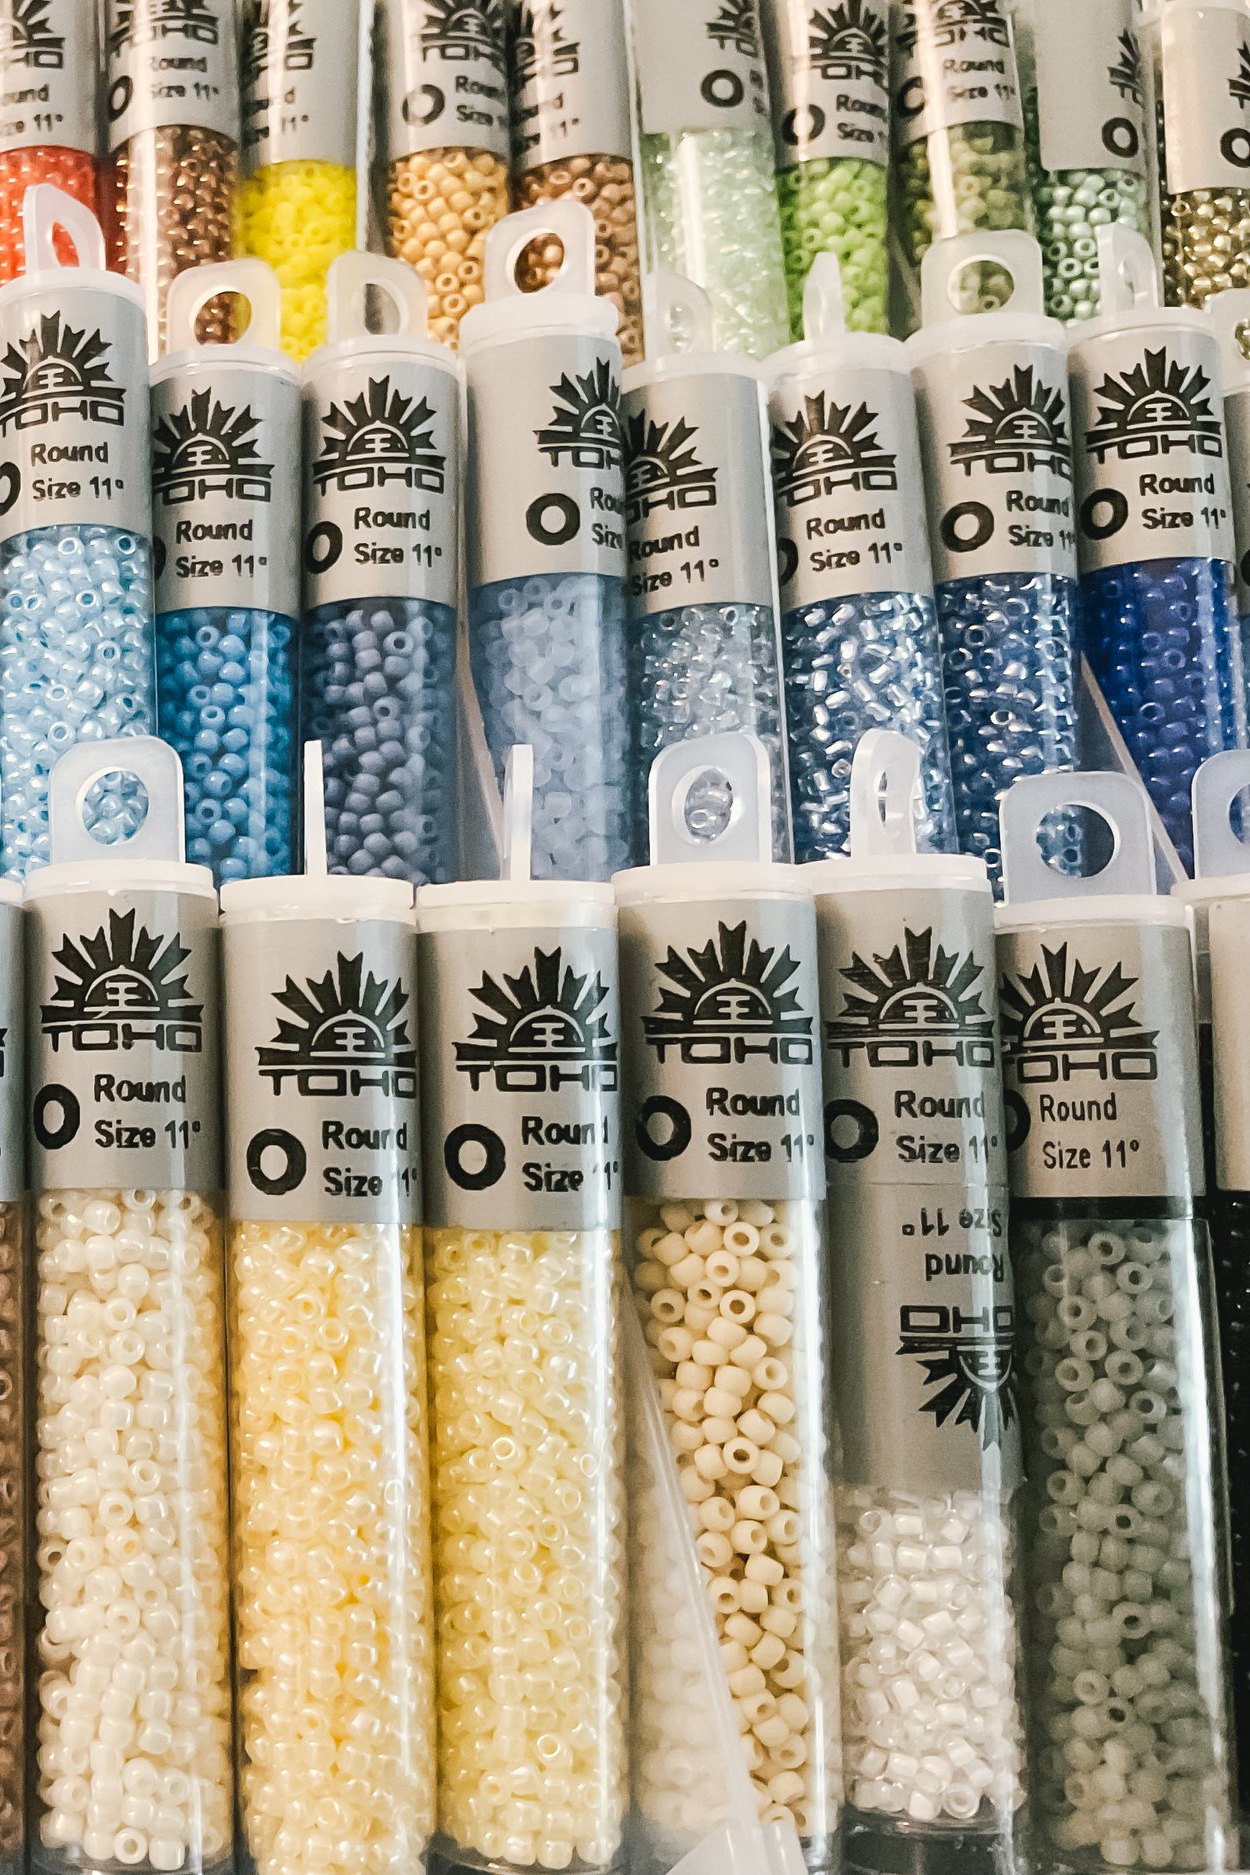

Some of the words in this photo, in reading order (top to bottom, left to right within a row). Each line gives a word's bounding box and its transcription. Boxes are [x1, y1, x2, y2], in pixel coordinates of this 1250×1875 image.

[31, 442, 108, 466] Round
[540, 444, 622, 471] TOH
[1085, 435, 1222, 465] TOHO
[32, 478, 80, 501] Size
[153, 478, 271, 506] OHO
[313, 466, 444, 497] TOHO
[778, 470, 897, 508] OHO
[1140, 474, 1215, 496] Round
[626, 486, 717, 524] OHO
[1007, 489, 1069, 517] Round
[176, 519, 253, 543] Round
[354, 507, 430, 531] Round
[806, 509, 885, 540] Round
[1142, 508, 1193, 530] Size
[628, 527, 699, 561] Round
[1008, 525, 1053, 548] Size
[176, 557, 223, 578] Size
[354, 543, 405, 566] Size
[810, 548, 861, 571] Size
[631, 568, 672, 595] Size
[43, 1024, 202, 1052] TOHO
[644, 1038, 813, 1066] TOHO
[826, 1040, 995, 1068] TOHO
[1003, 1051, 1157, 1082] OHO
[94, 1075, 186, 1103] Round
[258, 1066, 416, 1098] TOHO
[455, 1062, 619, 1092] TOHO
[706, 1089, 800, 1116] Round
[894, 1090, 986, 1120] Round
[1040, 1094, 1118, 1121] Round
[95, 1122, 154, 1149] Size
[708, 1133, 771, 1162] Size
[896, 1136, 959, 1163] Size
[1043, 1140, 1090, 1169] Size
[322, 1168, 382, 1197] Size
[521, 1164, 583, 1191] Size
[925, 1253, 1004, 1281] Round
[900, 1305, 1014, 1333] OHO
